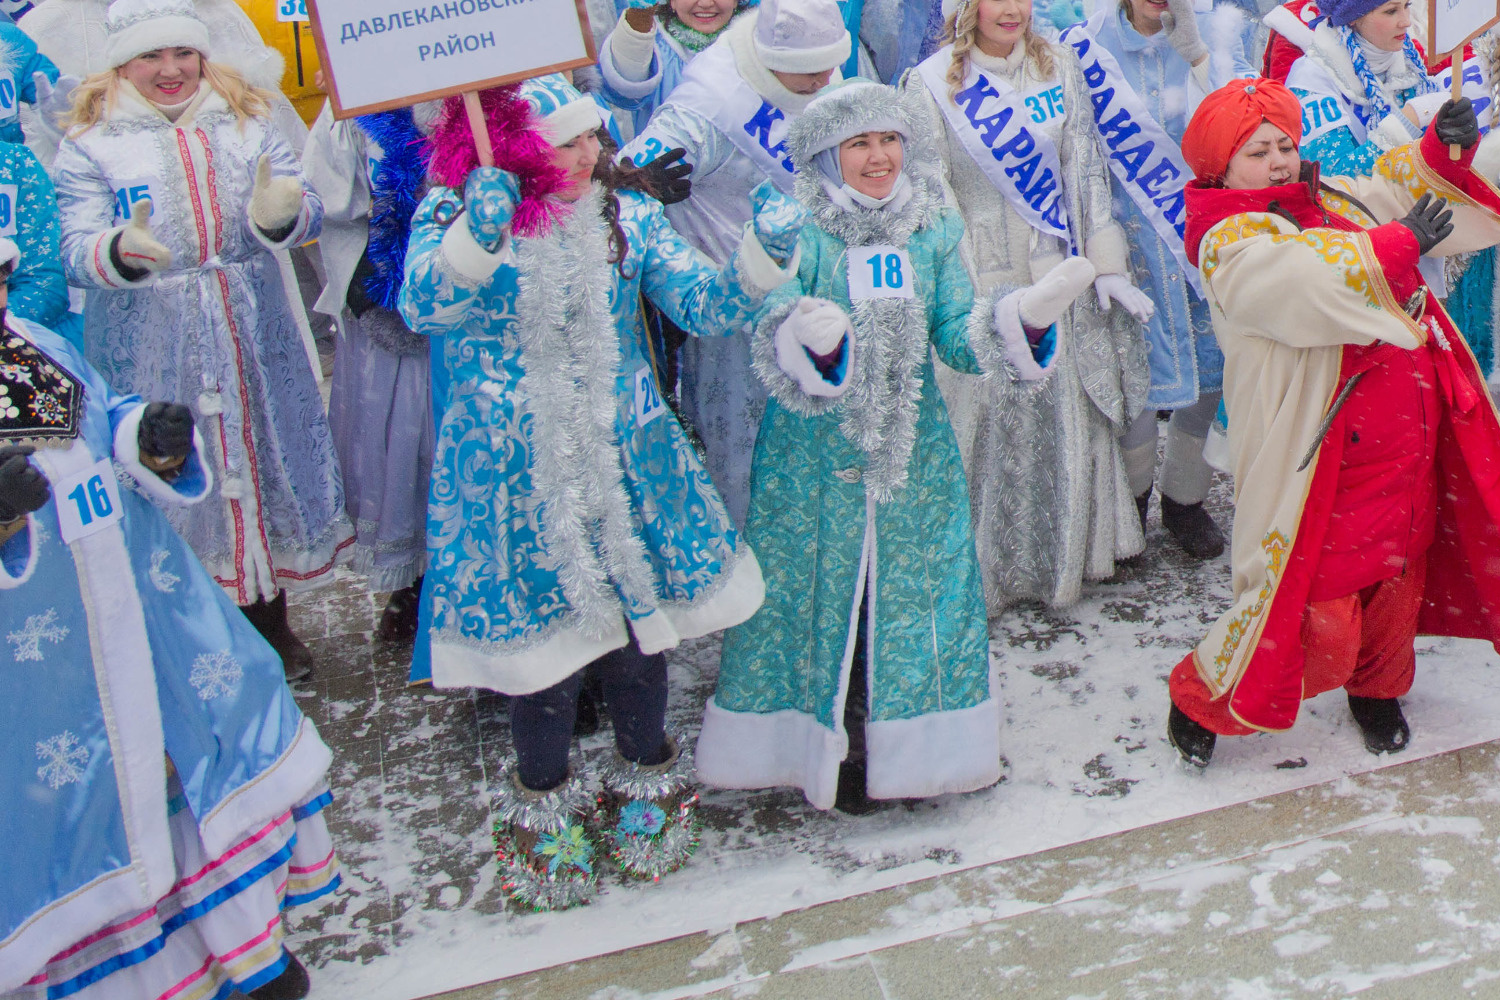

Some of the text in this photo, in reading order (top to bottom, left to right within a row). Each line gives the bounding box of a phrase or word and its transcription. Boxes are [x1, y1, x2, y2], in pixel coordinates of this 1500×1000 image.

[418, 30, 496, 62] РАЙОН
[1024, 84, 1065, 124] 375
[866, 253, 904, 289] 18
[68, 478, 114, 527] 16
